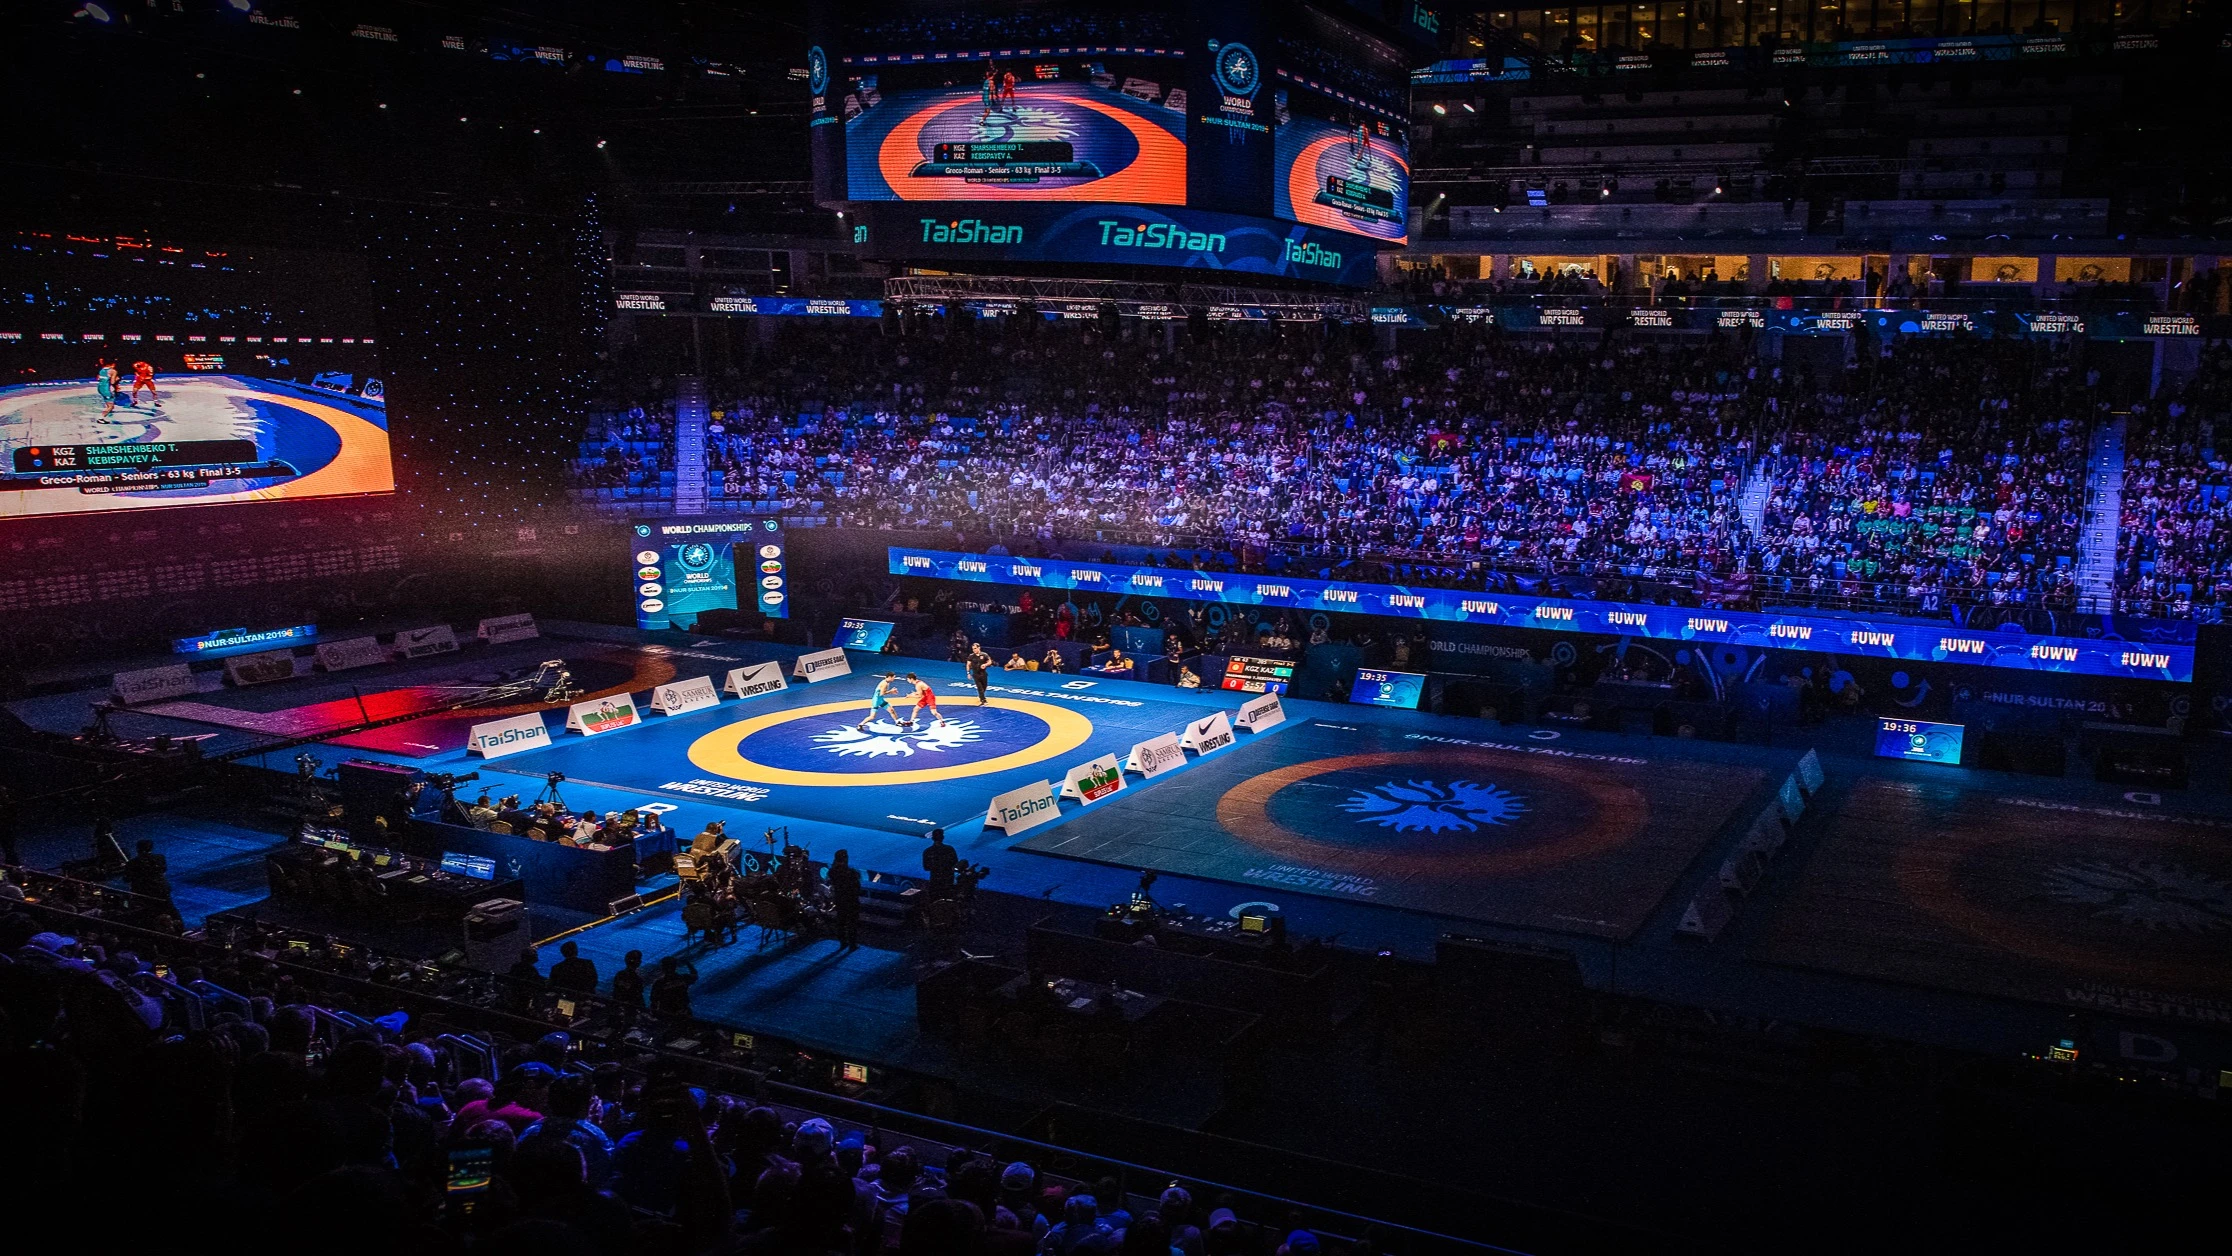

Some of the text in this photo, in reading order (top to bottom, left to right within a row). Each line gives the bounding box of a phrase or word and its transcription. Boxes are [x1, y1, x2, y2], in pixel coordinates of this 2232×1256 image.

[1224, 96, 1251, 108] WORLD
[1024, 167, 1031, 175] kg
[920, 219, 1023, 244] TaiShan
[1098, 222, 1226, 252] TaiShan
[1284, 237, 1342, 268] TaiShan
[616, 300, 665, 310] WRESTLING
[710, 303, 757, 312] WRESTLING
[806, 305, 850, 314] WRESTLING
[1626, 317, 1672, 326] RESTLING
[2144, 324, 2200, 335] WRESTLING
[53, 444, 178, 456] KGZ SHARSHENBEKO T.
[54, 455, 162, 466] KAZ KEBISPAYEV A.
[41, 474, 112, 485] Greco-Roman
[121, 472, 159, 481] Seniors
[168, 470, 180, 479] 63
[182, 470, 195, 479] kg
[200, 468, 223, 477] Final
[225, 468, 241, 476] 3-5
[662, 523, 752, 534] WORLD CHAMPIONSHIPS
[903, 556, 930, 568] #UWW
[958, 560, 986, 572] #UWW
[1012, 565, 1042, 577] #UWW
[1071, 569, 1101, 582] #UWW
[1132, 574, 1163, 587] #UWW
[1192, 579, 1223, 592] #UWW
[1257, 584, 1290, 598] #UWW
[1324, 589, 1358, 602] #UWW
[1389, 594, 1425, 608] #UWW
[1461, 600, 1498, 614] #UWW
[1922, 595, 1938, 611] A2
[1536, 606, 1573, 620] #UWW
[1608, 611, 1647, 626] #UWW
[842, 620, 864, 629] 19:35
[1688, 618, 1728, 633] #UWW
[1770, 625, 1812, 640] #UWW
[1851, 631, 1894, 646] #UWW
[204, 631, 287, 649] NUR-SULTAN 2019
[1940, 638, 1985, 653] #UWW
[1430, 641, 1531, 658] ORLD CHAMPIONSHIPS
[2031, 645, 2078, 661] #UWW
[814, 655, 845, 668] DEFENSE SOAP
[2121, 652, 2170, 668] #UWW
[1360, 672, 1387, 681] 19:35
[682, 686, 714, 698] SAMRUK
[741, 680, 782, 697] WRESTLING
[956, 683, 1084, 700] NR-SULTAN
[685, 694, 716, 704] KAZYNA
[1254, 704, 1269, 717] DEFENSE
[1883, 722, 1917, 733] 19:36
[478, 725, 546, 748] TaiShan
[1199, 732, 1230, 753] WRESTLING
[1156, 743, 1180, 758] SAMRUK
[1419, 735, 1574, 757] NUR-SULTAN
[1158, 752, 1182, 764] KAZYNA
[659, 782, 768, 802] WRESTLING
[690, 779, 771, 796] UNITED WORLD
[1000, 794, 1055, 824] TaiShan
[1268, 863, 1374, 885] UNITED WORLD
[1243, 868, 1380, 898] WRESTLING
[2118, 1030, 2178, 1062] D
